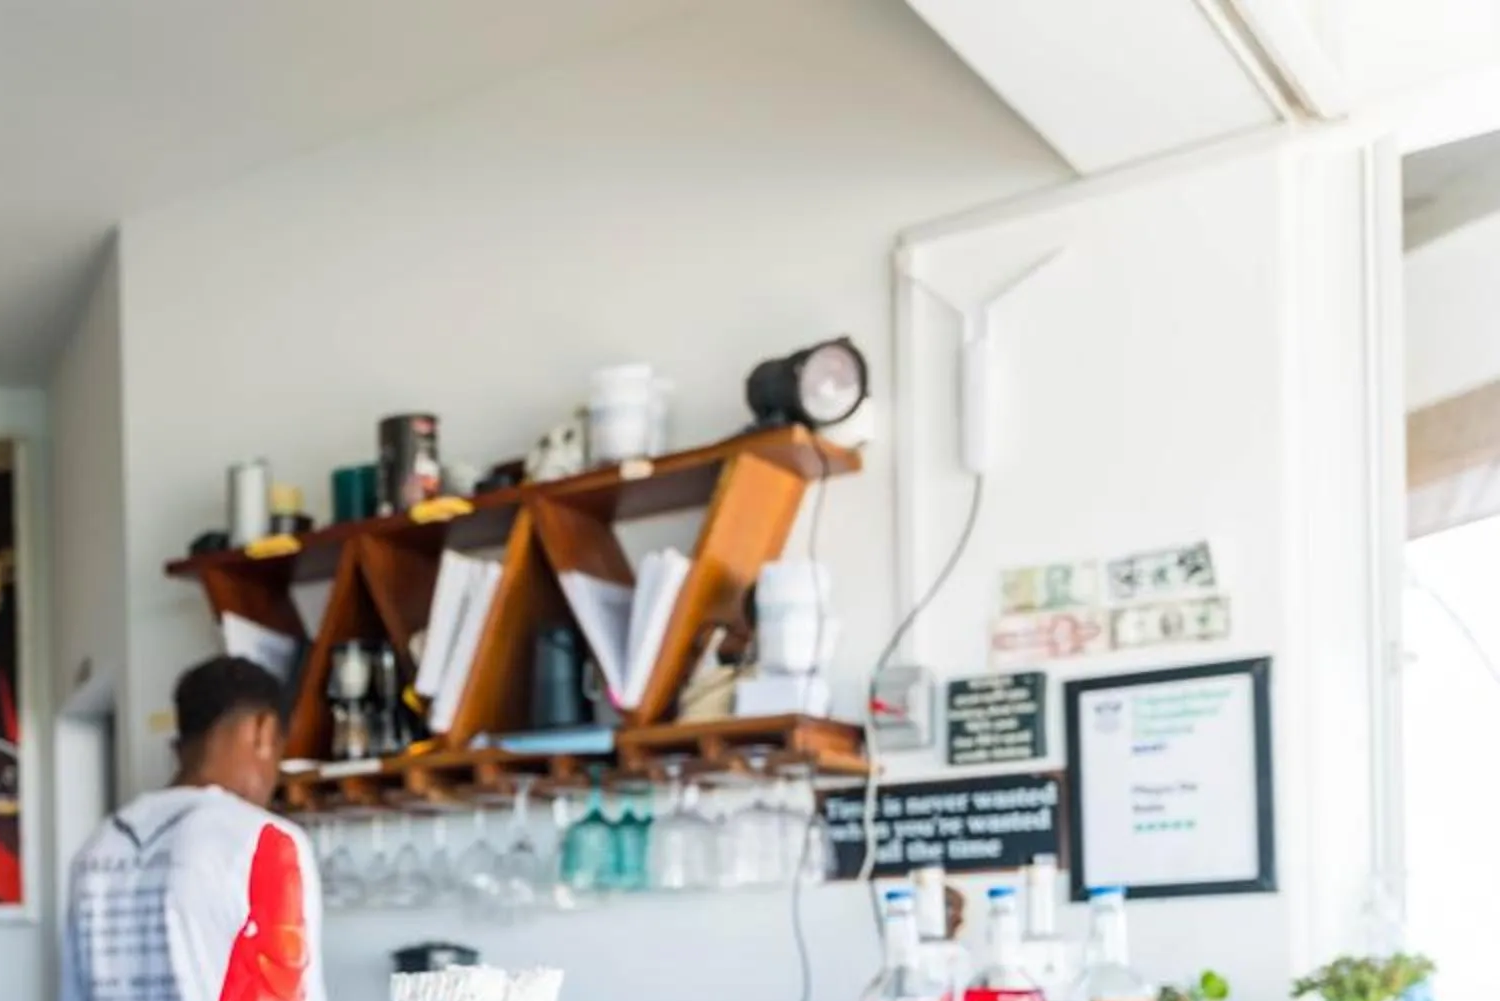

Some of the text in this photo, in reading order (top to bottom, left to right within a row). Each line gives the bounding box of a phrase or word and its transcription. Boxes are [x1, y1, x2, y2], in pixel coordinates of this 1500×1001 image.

[882, 796, 901, 818] is
[905, 792, 969, 816] never
[906, 838, 943, 863] the
[947, 838, 1003, 860] time
